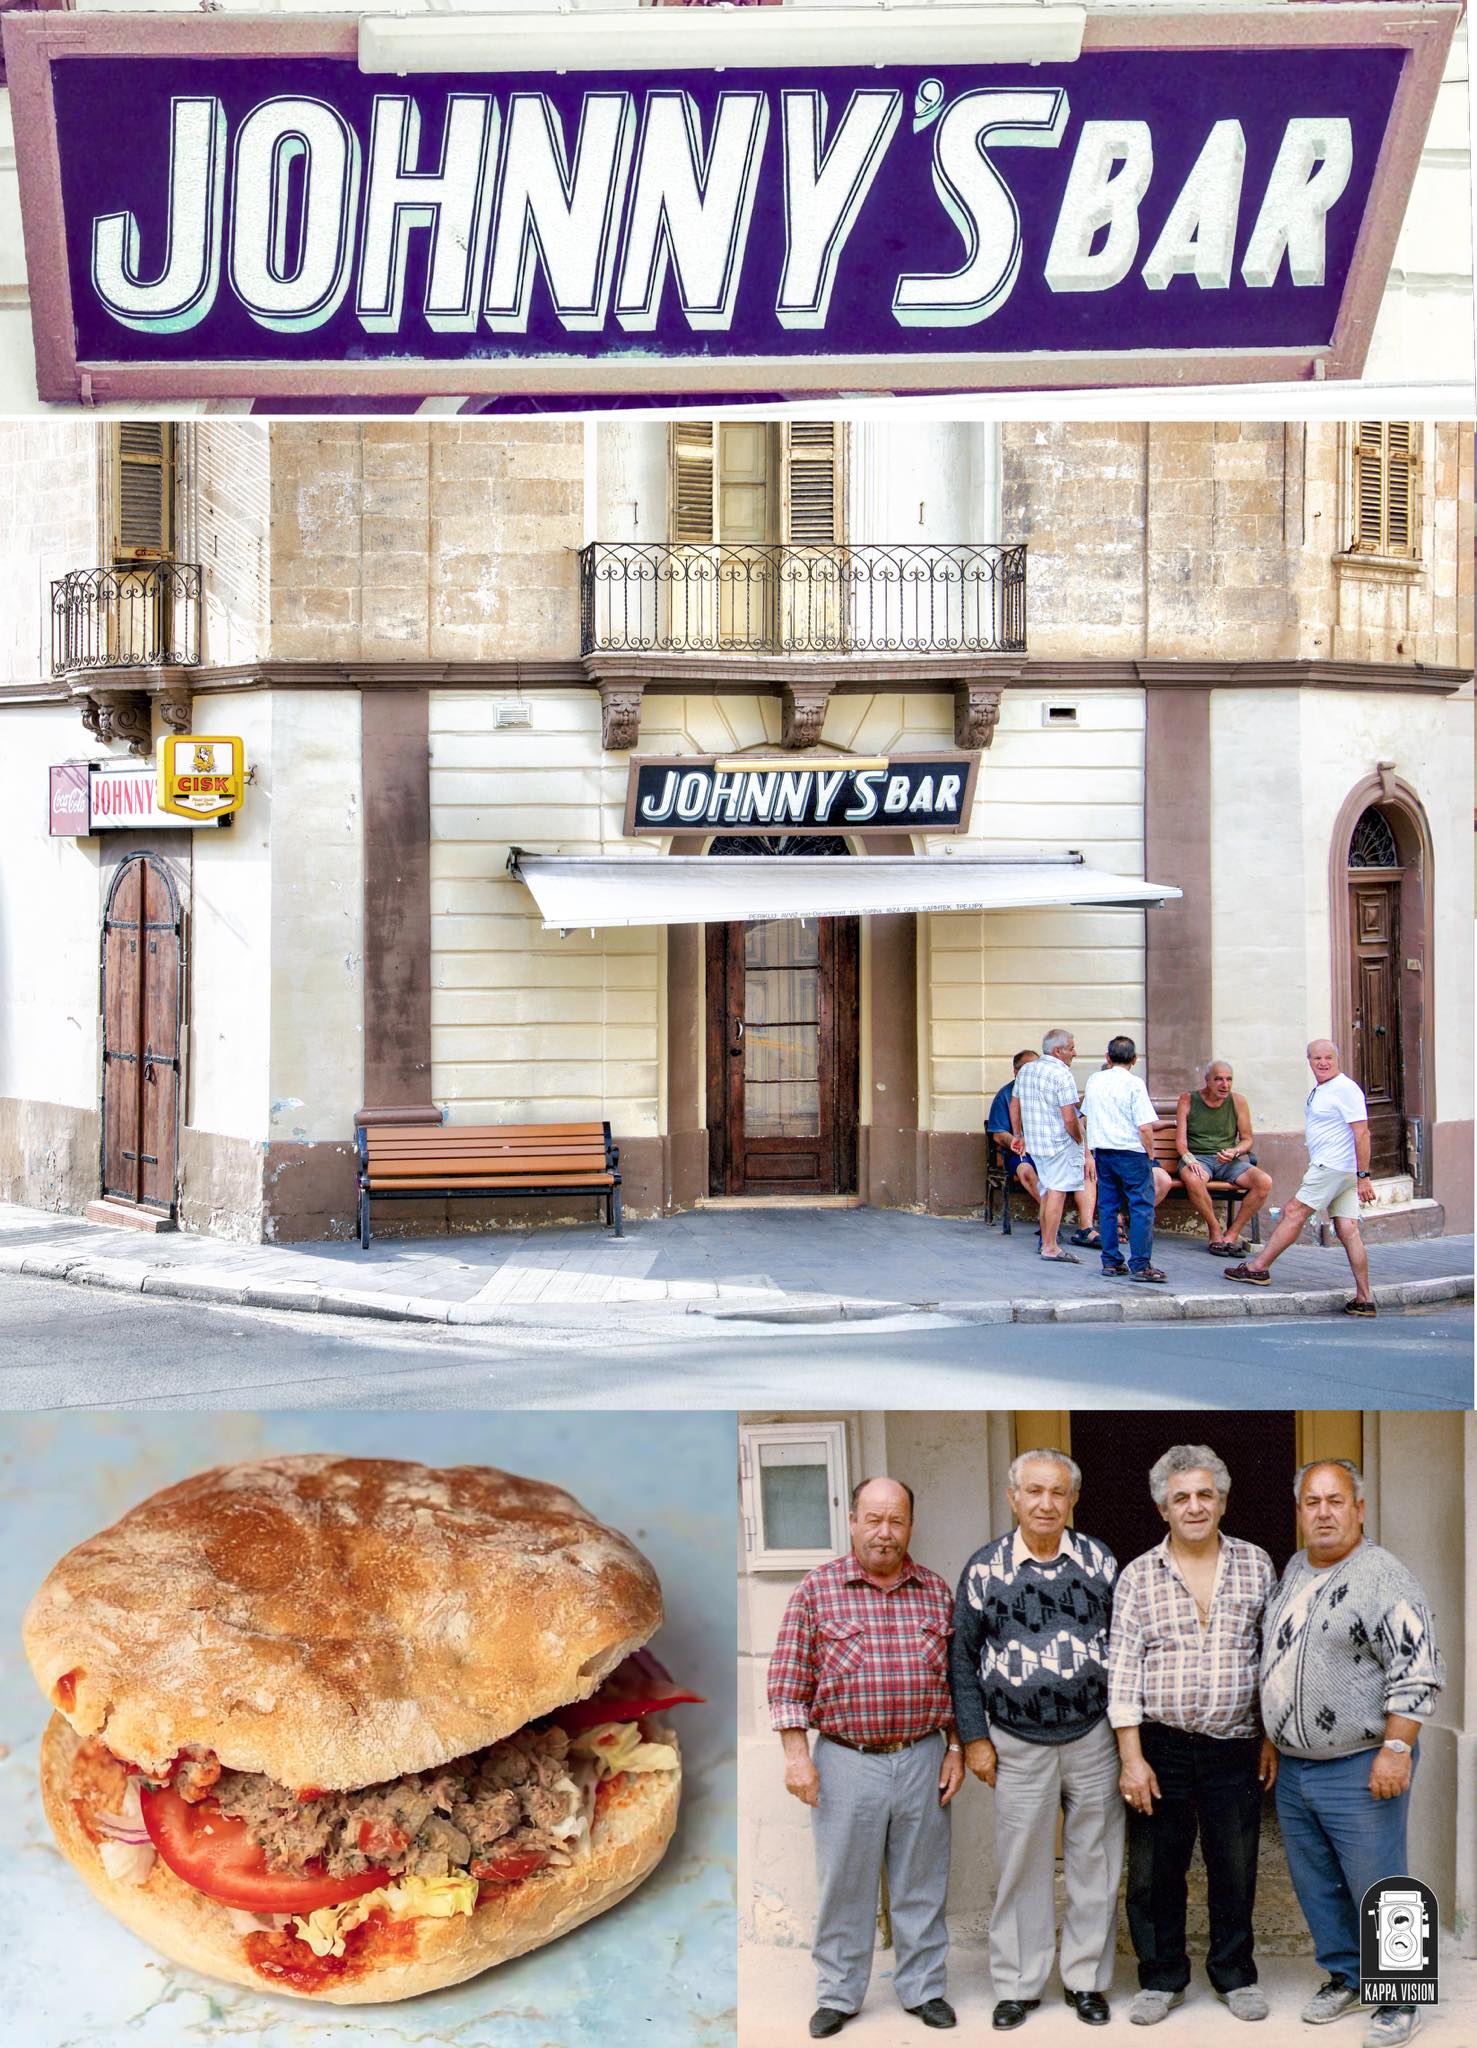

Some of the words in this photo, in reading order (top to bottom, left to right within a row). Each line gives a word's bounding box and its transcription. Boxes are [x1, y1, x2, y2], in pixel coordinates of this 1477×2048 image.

[92, 78, 1071, 334] JOHNNY'S
[1044, 118, 1353, 293] BAR
[93, 779, 158, 815] JOHNNY
[178, 776, 229, 793] CISK
[641, 770, 888, 822] JOHNNY'S
[883, 774, 961, 813] BAR
